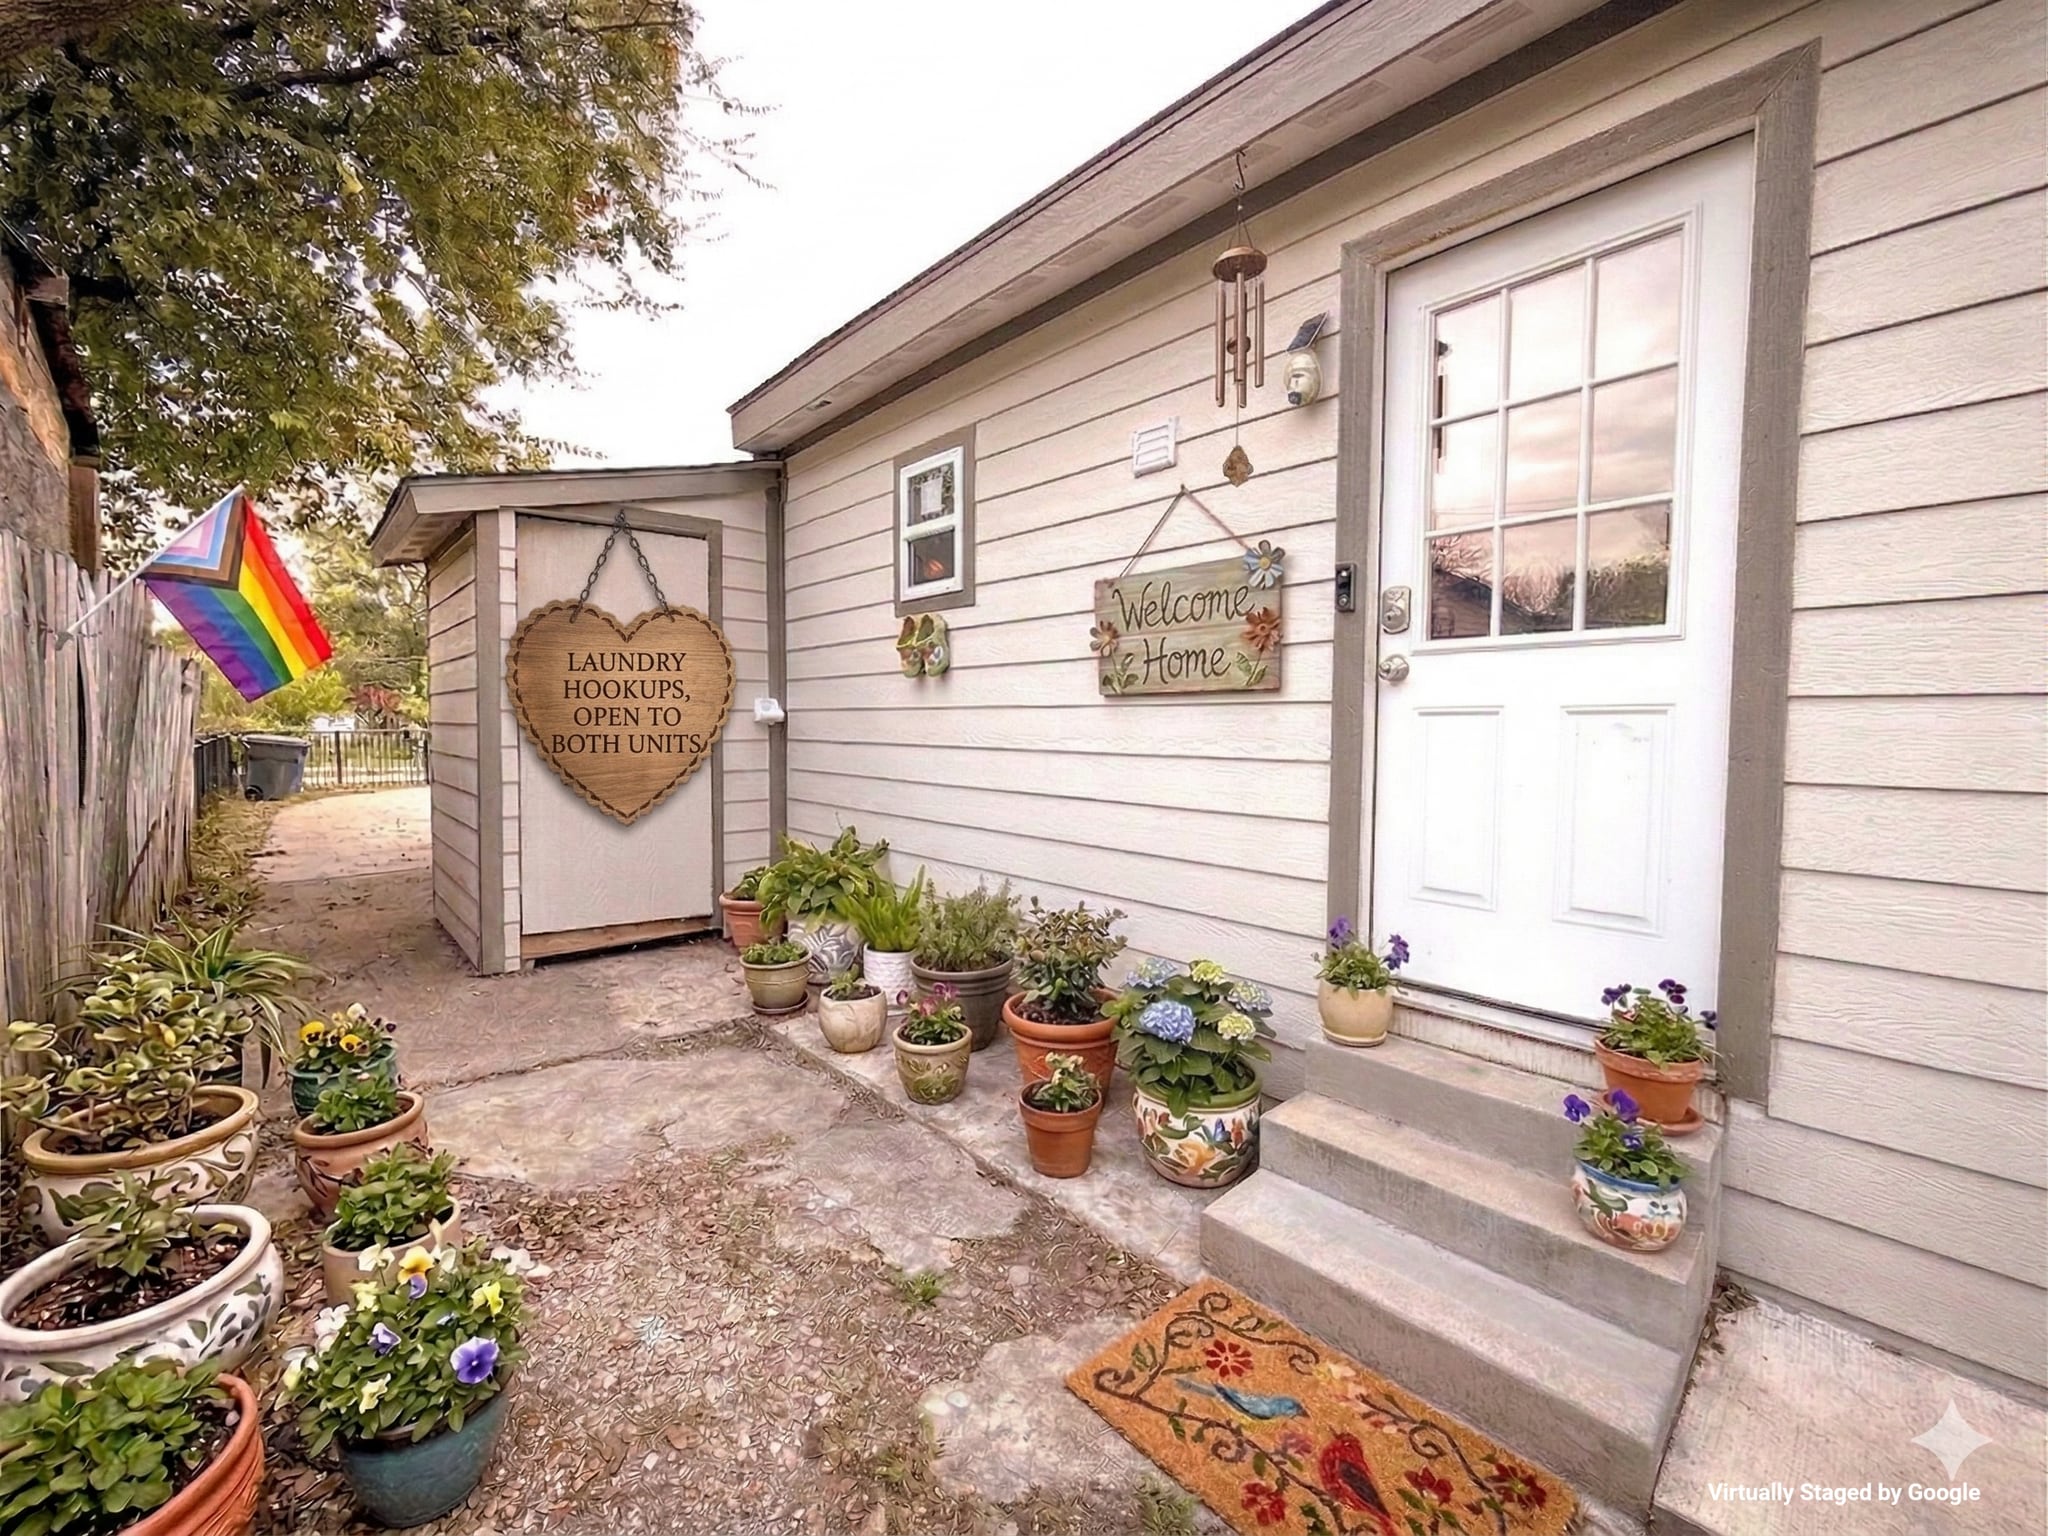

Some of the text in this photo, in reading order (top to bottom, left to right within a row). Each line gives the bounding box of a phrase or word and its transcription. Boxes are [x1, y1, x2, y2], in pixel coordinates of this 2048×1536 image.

[1112, 581, 1255, 632] Welcome
[567, 652, 687, 672] LAUNDRY
[1143, 637, 1231, 685] Home
[563, 679, 691, 703] HOOKUPS,
[573, 706, 682, 727] OPEN TO
[551, 733, 701, 754] BOTH UNITS
